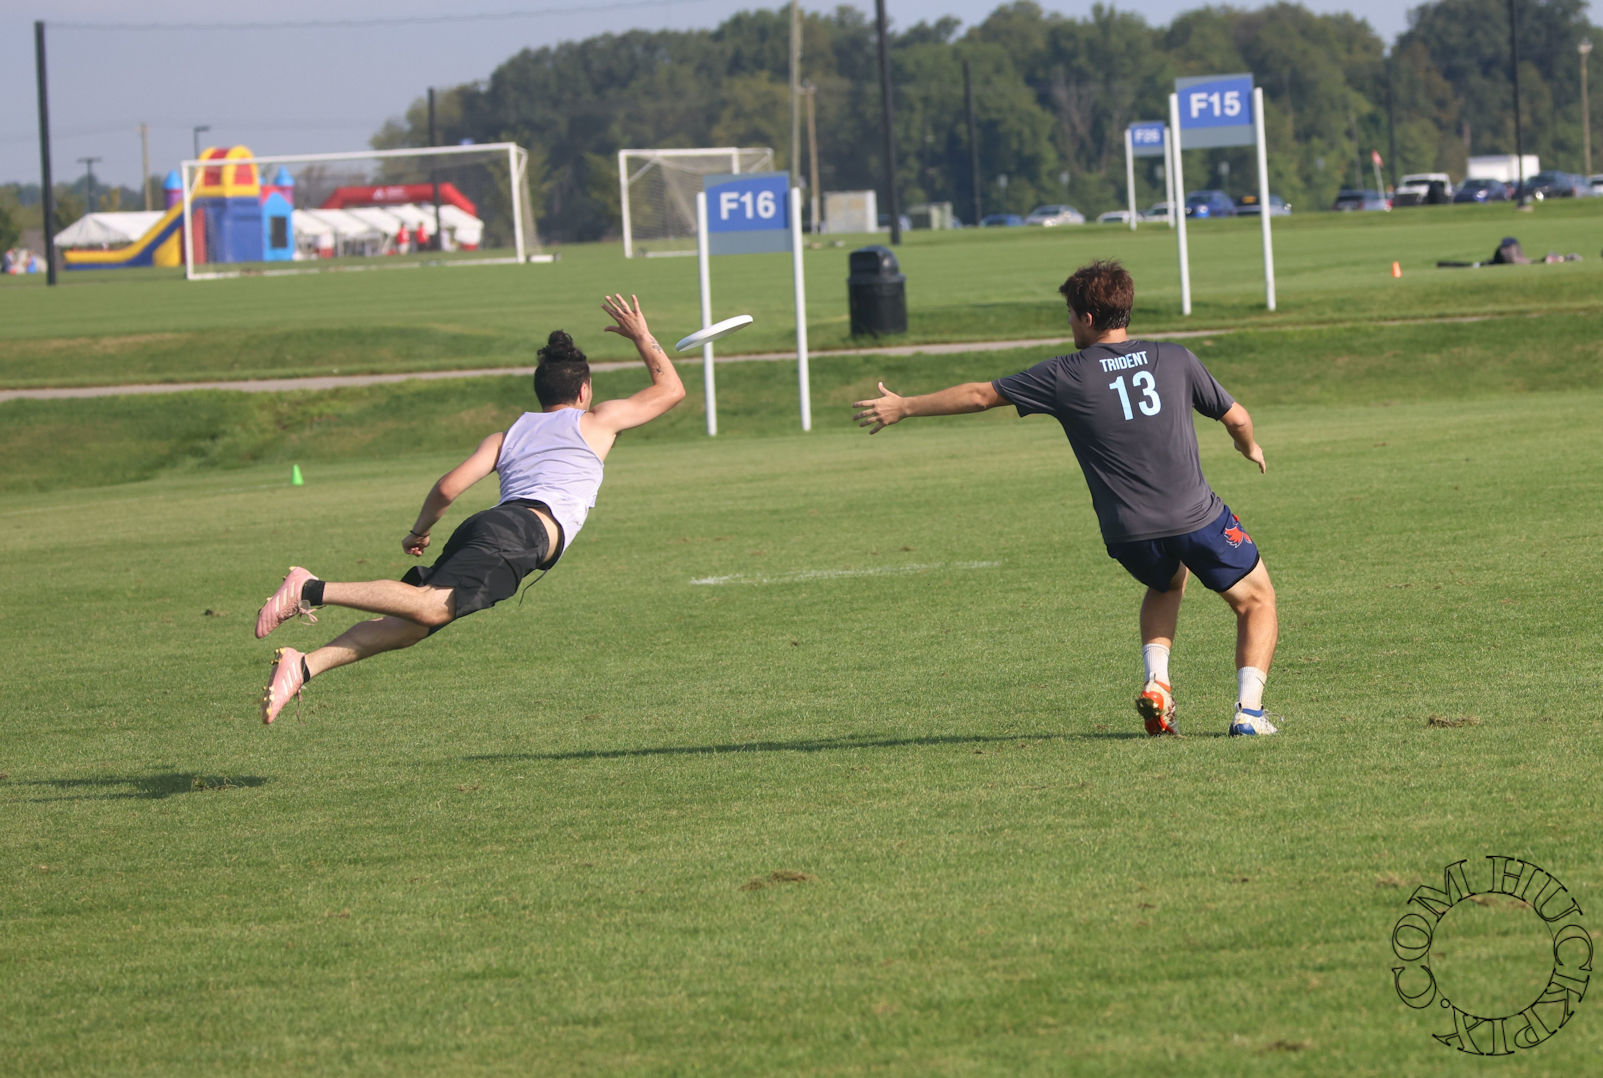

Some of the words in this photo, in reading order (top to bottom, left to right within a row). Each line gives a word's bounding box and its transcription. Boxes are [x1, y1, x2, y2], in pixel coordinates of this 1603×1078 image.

[1189, 91, 1241, 118] F15
[719, 190, 776, 220] F16
[1099, 350, 1148, 373] TRIDENT
[1108, 370, 1161, 421] 13
